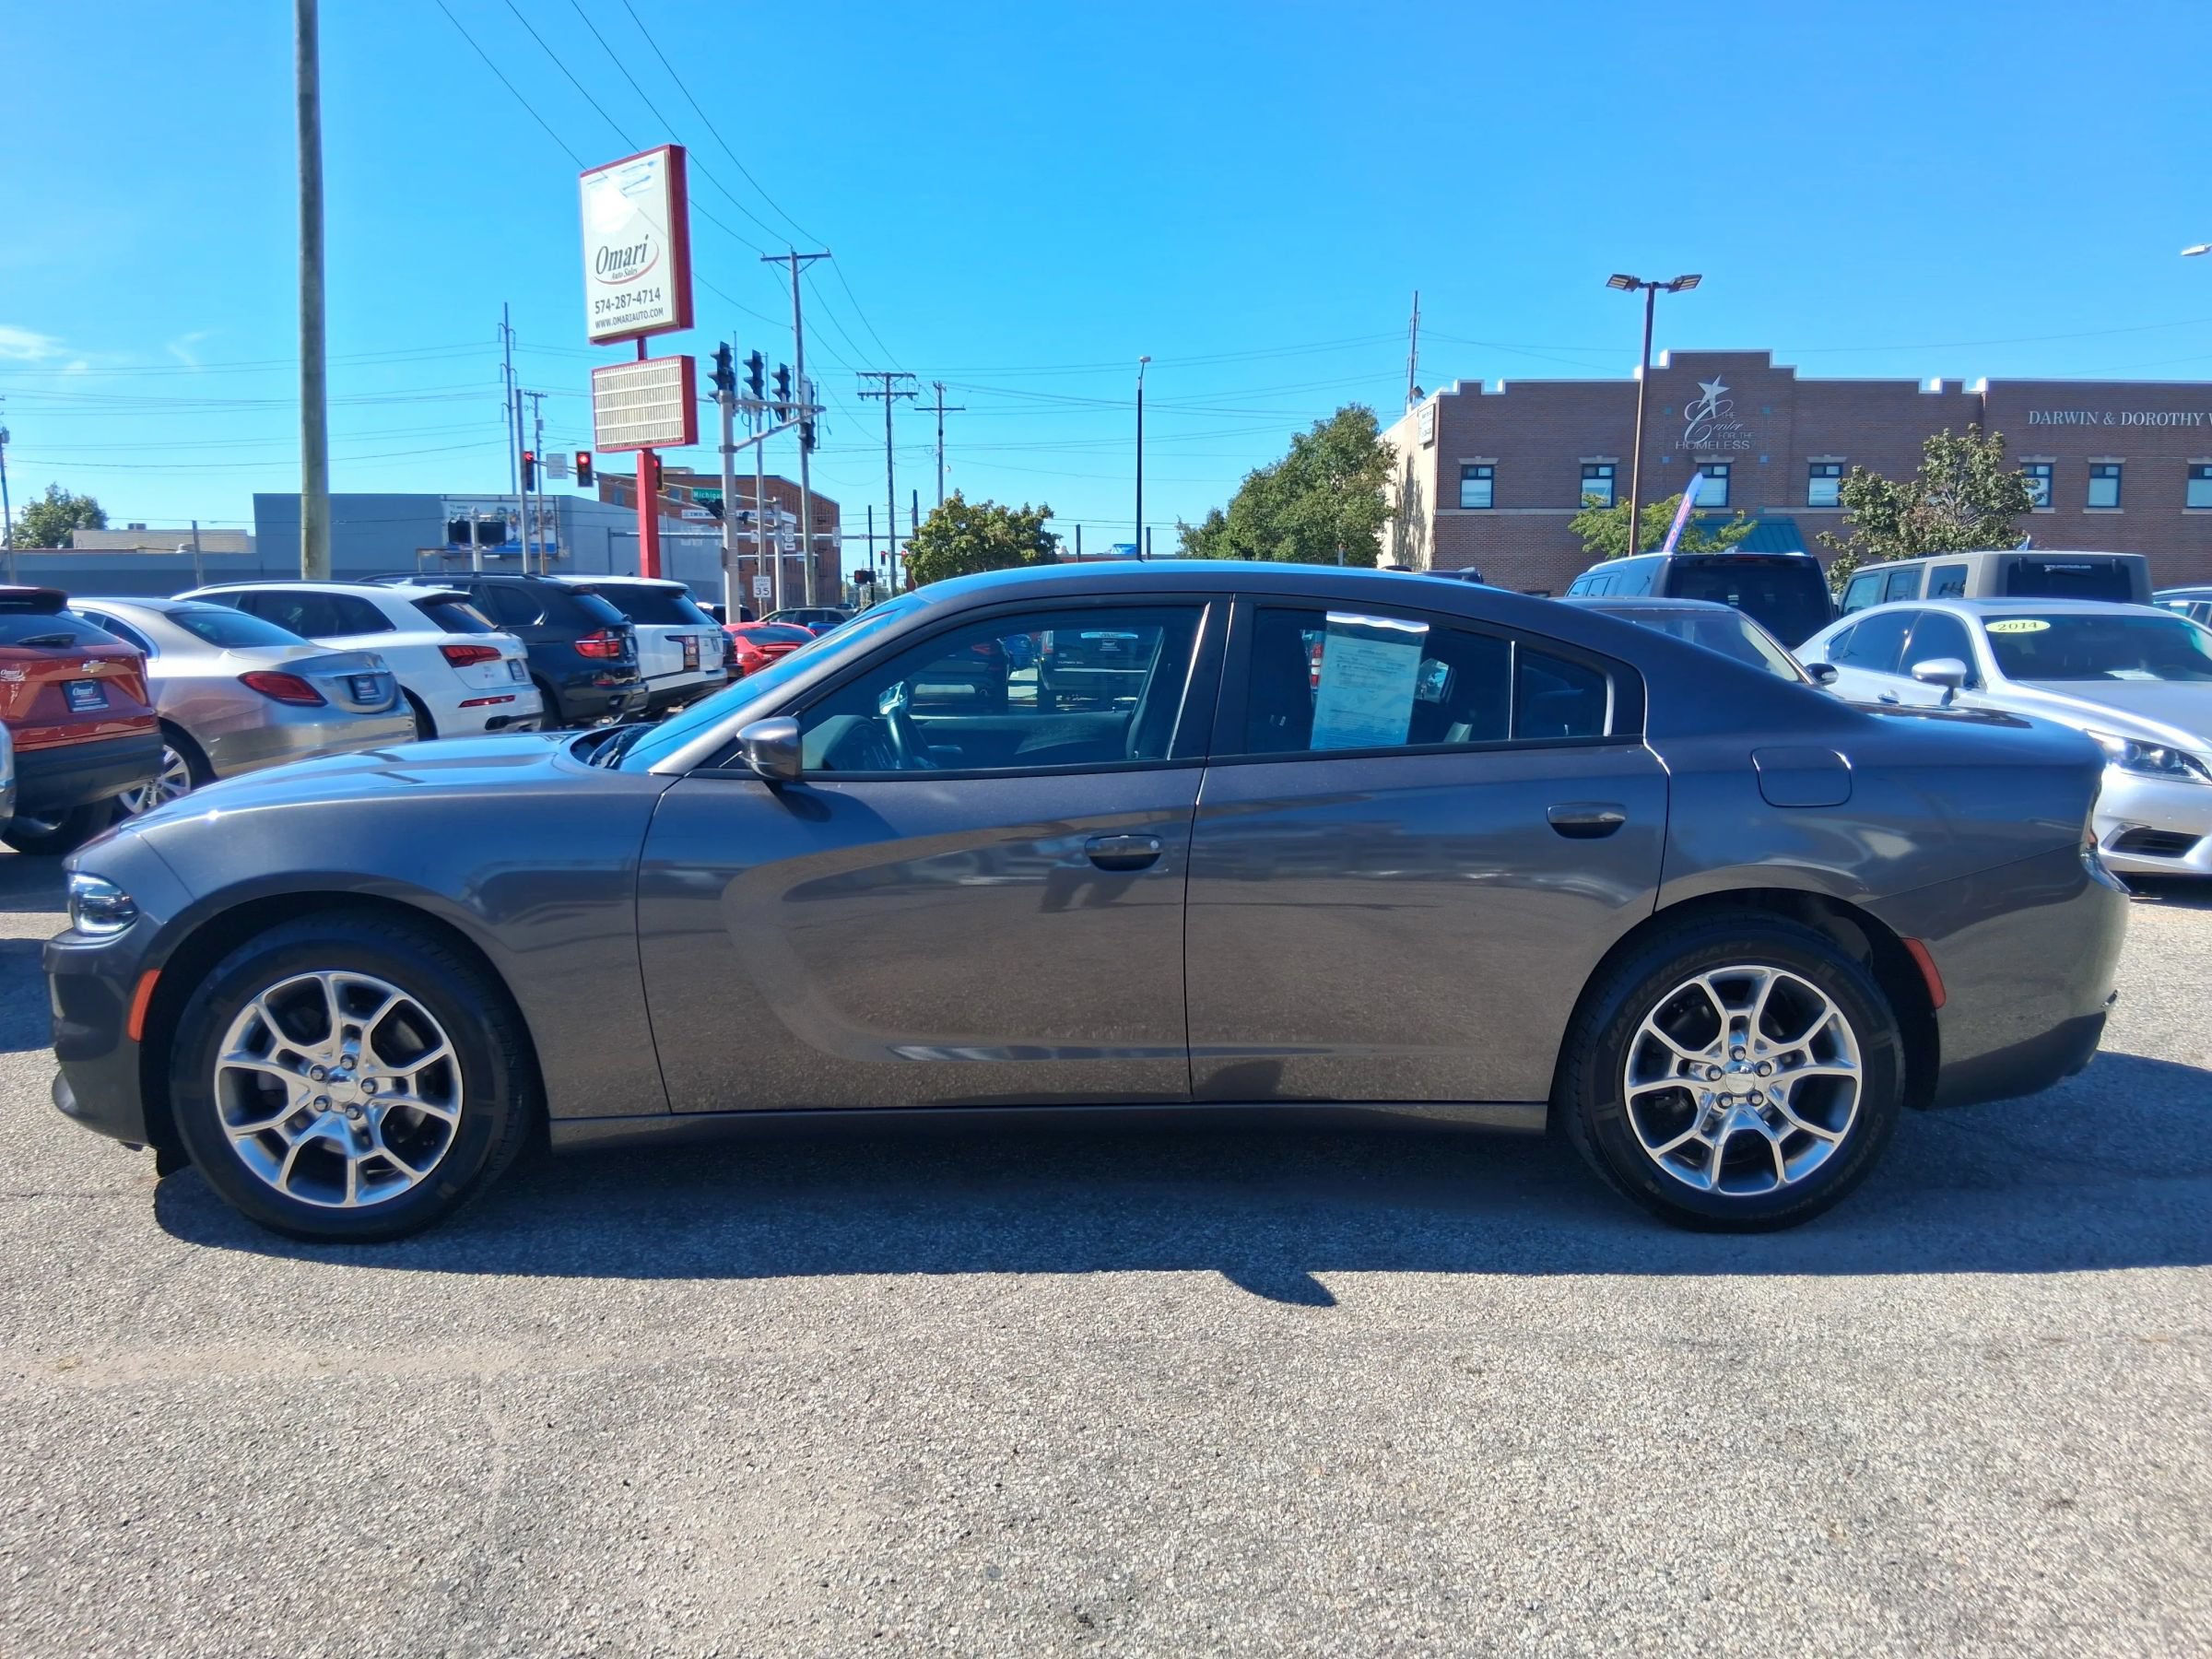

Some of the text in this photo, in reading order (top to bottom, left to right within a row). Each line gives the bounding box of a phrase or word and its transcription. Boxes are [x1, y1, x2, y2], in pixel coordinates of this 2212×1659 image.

[595, 234, 649, 275] Omari
[594, 288, 661, 314] 574-287-4714
[594, 308, 664, 329] WWW.OMARIAUTO.COM
[2028, 411, 2099, 425] DARWIN
[2103, 412, 2115, 426] &
[2122, 412, 2205, 426] DOROTHY
[1676, 441, 1750, 450] HOMELESS
[756, 587, 770, 595] 35
[1997, 622, 2037, 631] 2014
